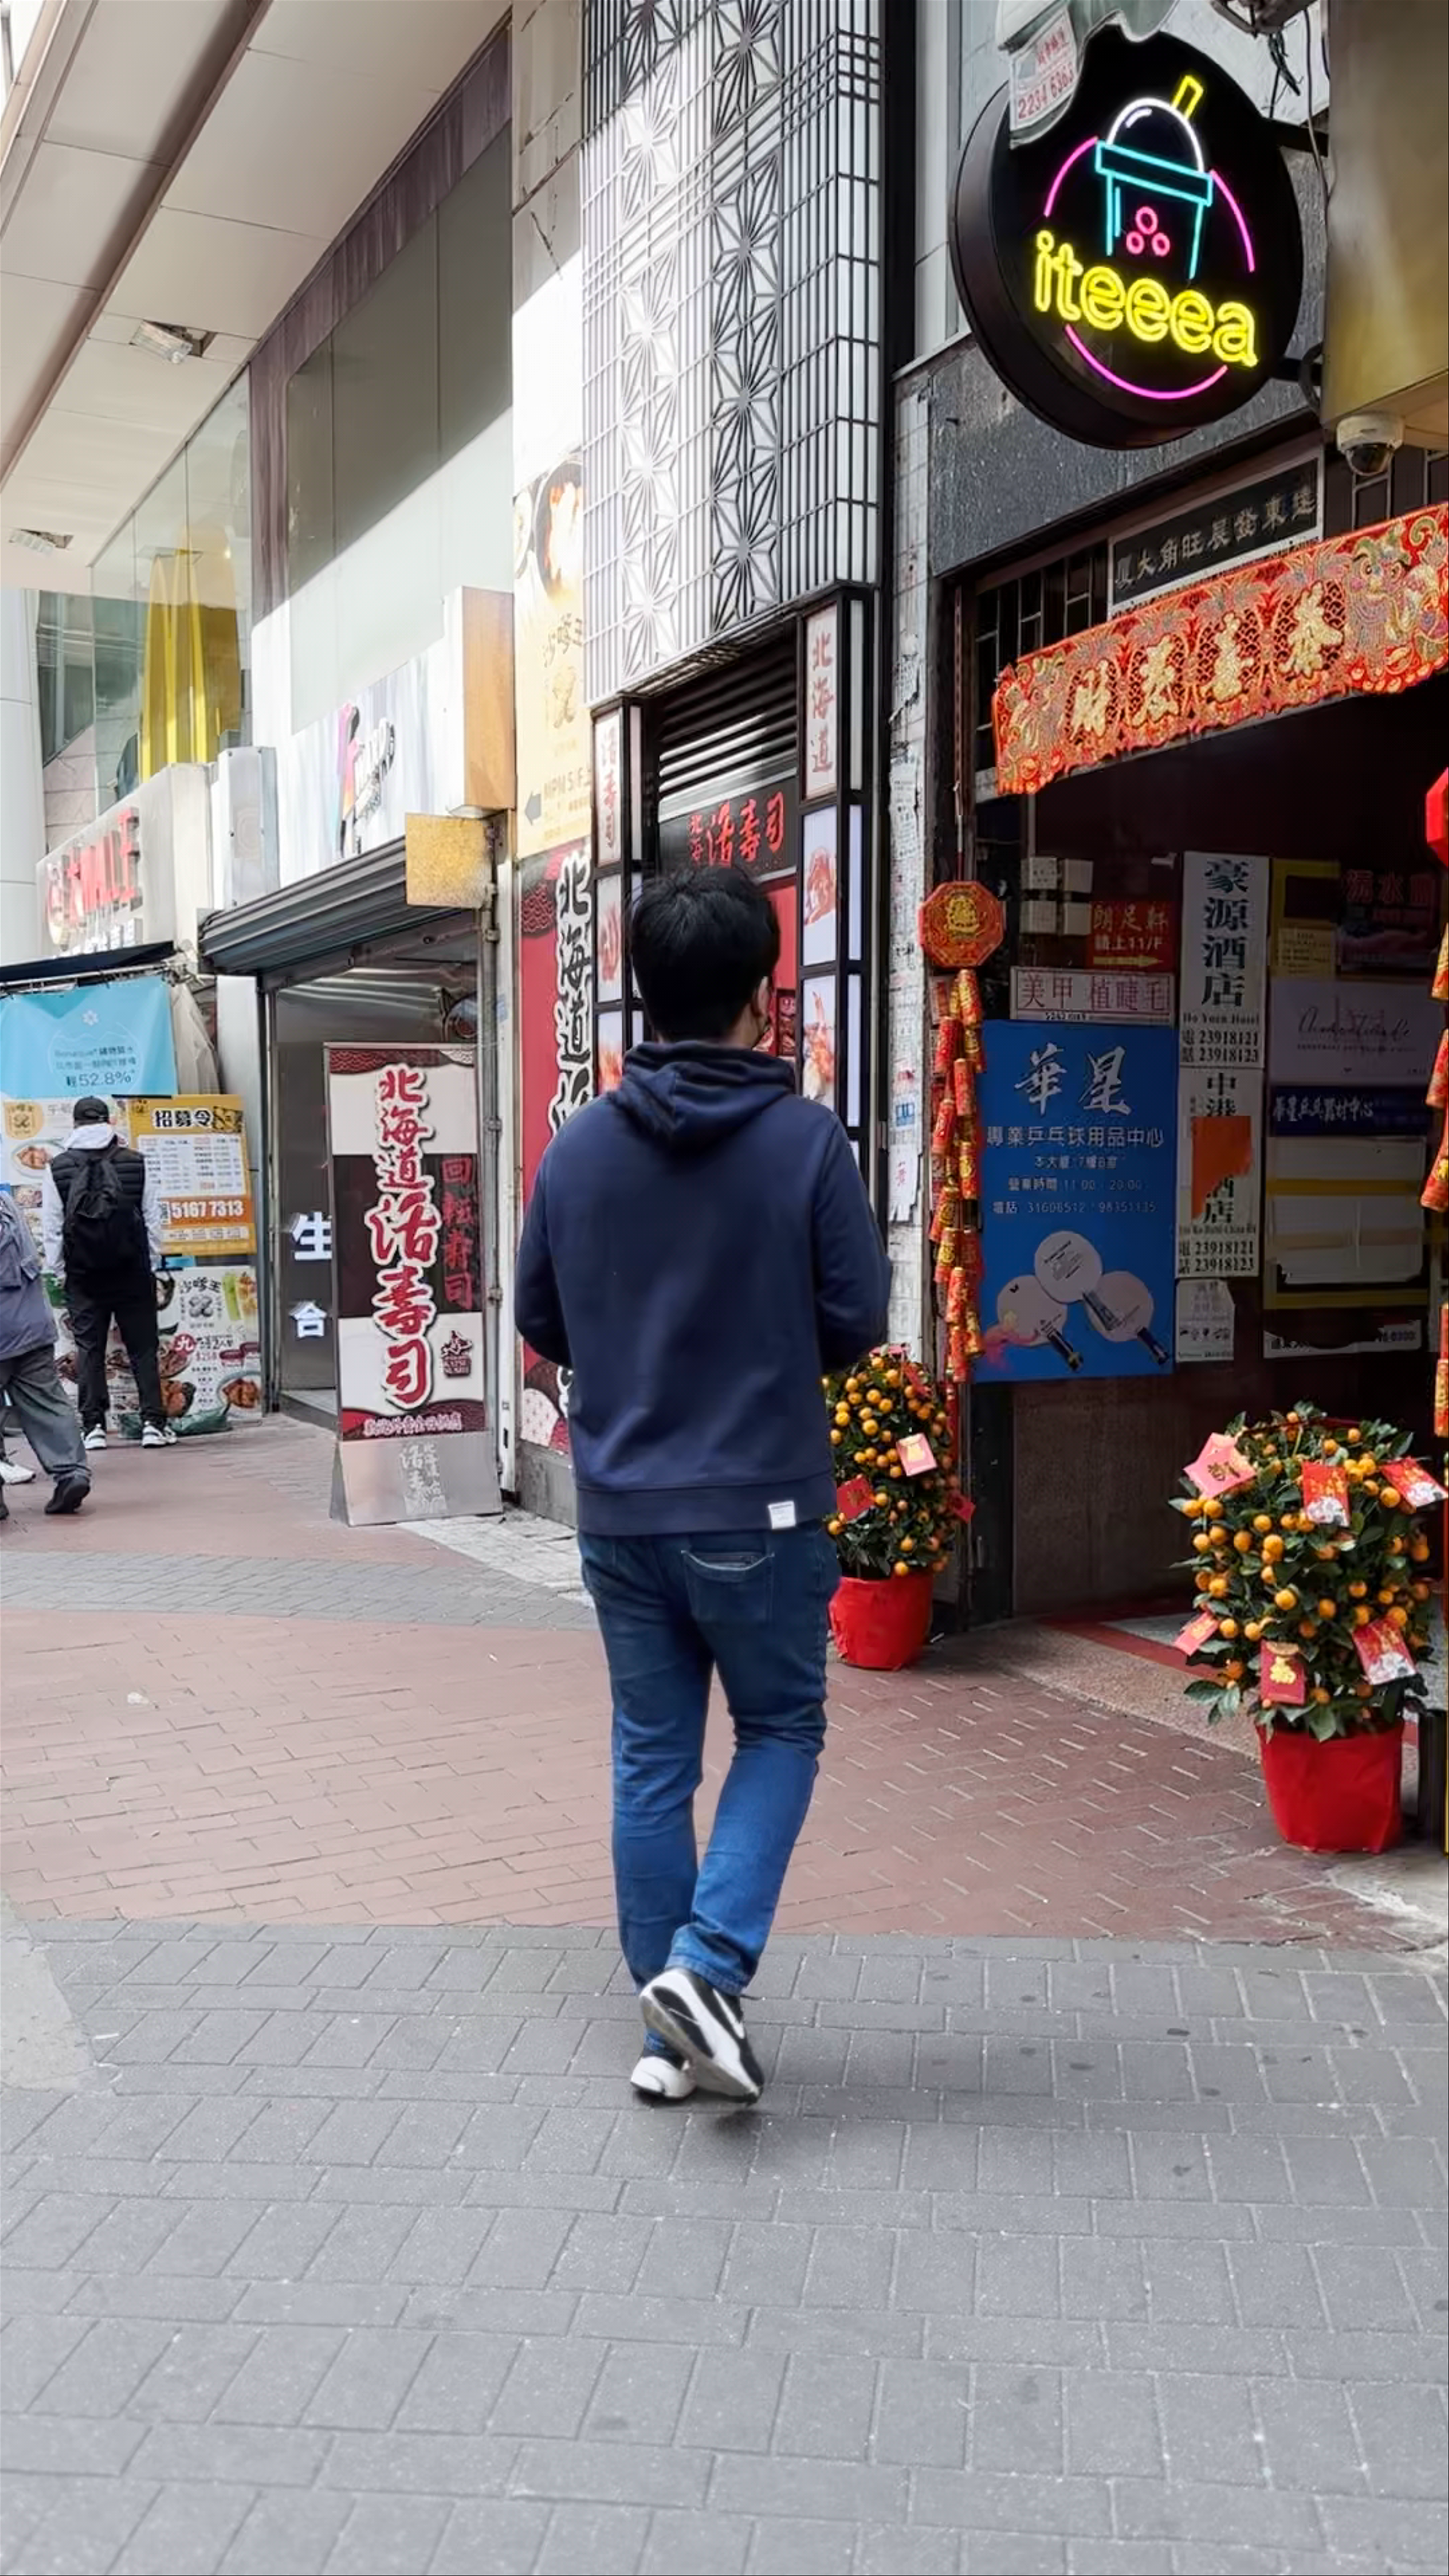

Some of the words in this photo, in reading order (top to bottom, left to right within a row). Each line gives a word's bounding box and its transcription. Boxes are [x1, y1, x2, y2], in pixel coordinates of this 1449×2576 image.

[1034, 229, 1258, 367] iteeea
[812, 632, 834, 774] 北海道
[1202, 859, 1248, 1007] 豪源酒店
[1021, 973, 1073, 1009] 美甲
[1199, 1030, 1258, 1046] 23918121
[1014, 1042, 1132, 1116] 華星
[987, 1126, 1164, 1148] 專業乒乓球用品中心
[1195, 1241, 1254, 1255] 23918121
